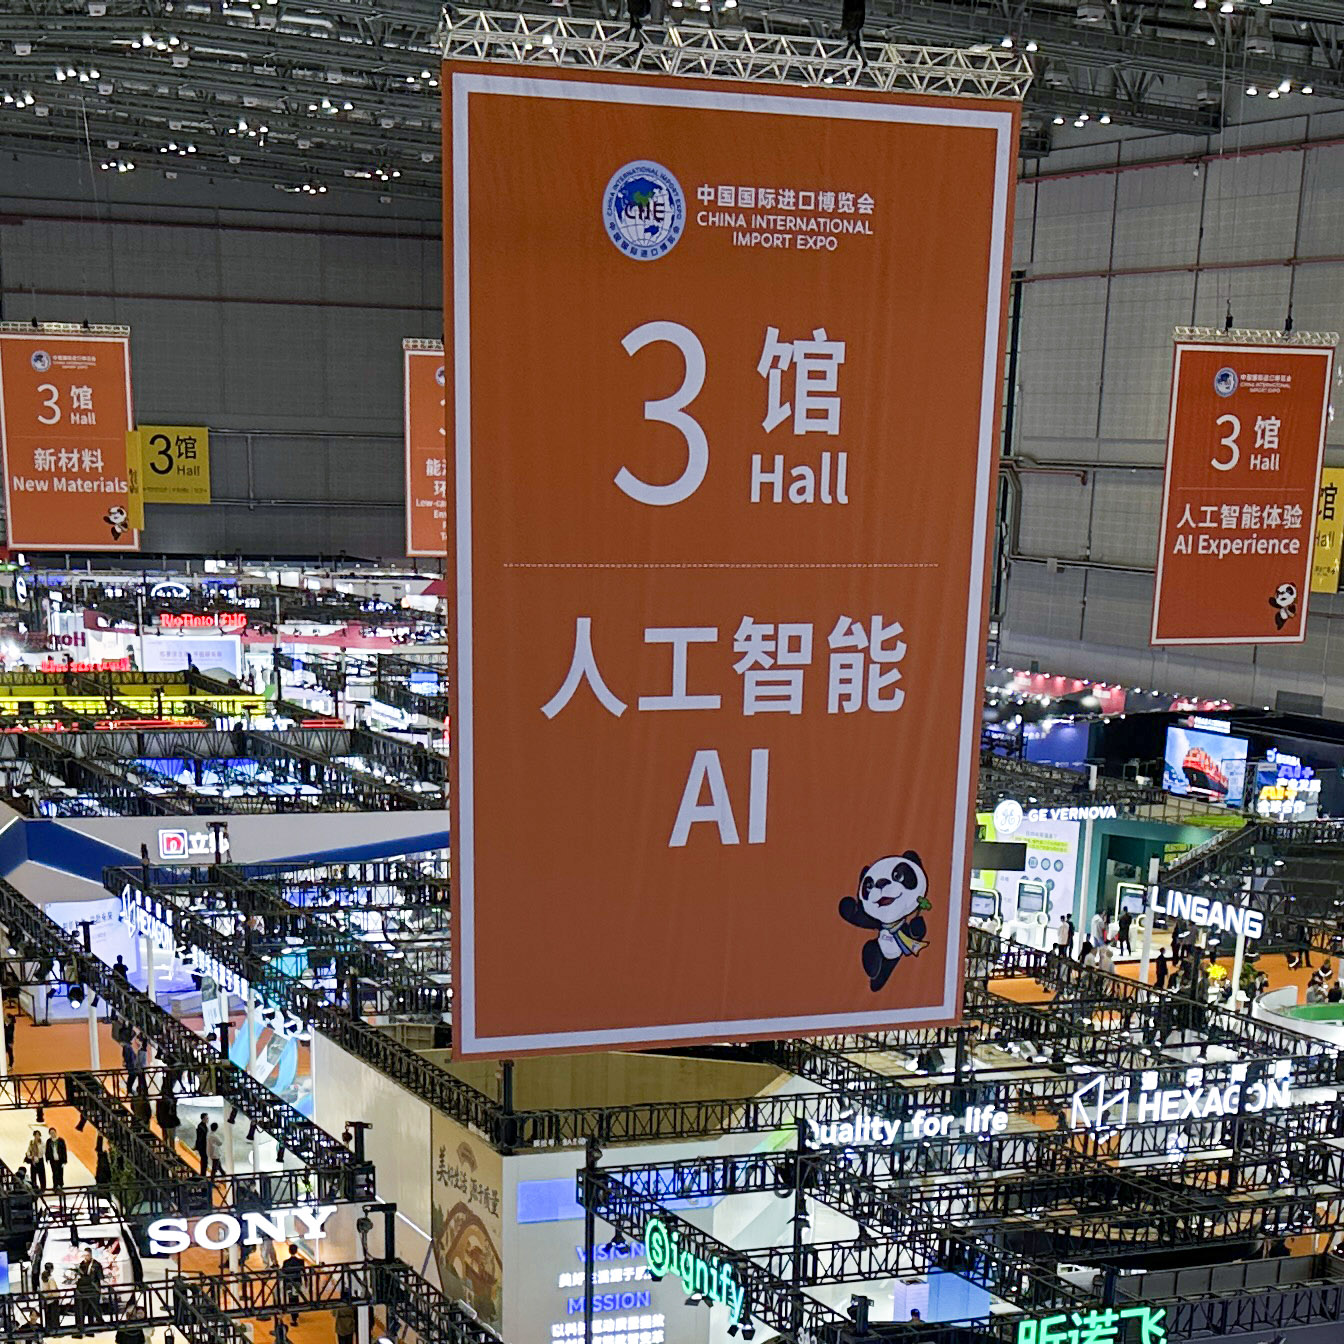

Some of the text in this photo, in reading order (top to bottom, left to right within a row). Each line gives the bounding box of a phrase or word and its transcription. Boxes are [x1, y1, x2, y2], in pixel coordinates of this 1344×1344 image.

[697, 184, 874, 214] 中国国际进口博览会
[697, 212, 873, 235] CHINA INTERNATIONAL
[733, 232, 838, 250] IMPORT EXPO
[37, 384, 93, 425] 3 馆
[70, 412, 96, 425] Hall
[614, 321, 846, 505] 3 馆
[149, 434, 197, 475] 3 馆
[1211, 414, 1281, 471] 3 馆
[34, 448, 105, 473] 新材料
[177, 465, 200, 476] Hall
[1250, 453, 1280, 471] Hall
[13, 476, 49, 492] New
[53, 477, 128, 493] Materials
[750, 452, 848, 505] Hall
[1176, 504, 1303, 530] 人工智能体验
[1174, 534, 1301, 560] AI Experience
[541, 614, 908, 719] 人工智能
[668, 748, 770, 847] AI
[1028, 805, 1117, 822] GE VERNOVA
[1150, 885, 1265, 940] LINGANG
[911, 1110, 954, 1138] for
[965, 1104, 1009, 1135] life
[148, 1205, 336, 1256] SONY
[645, 1217, 746, 1327] Signify
[567, 1290, 651, 1315] MSSION
